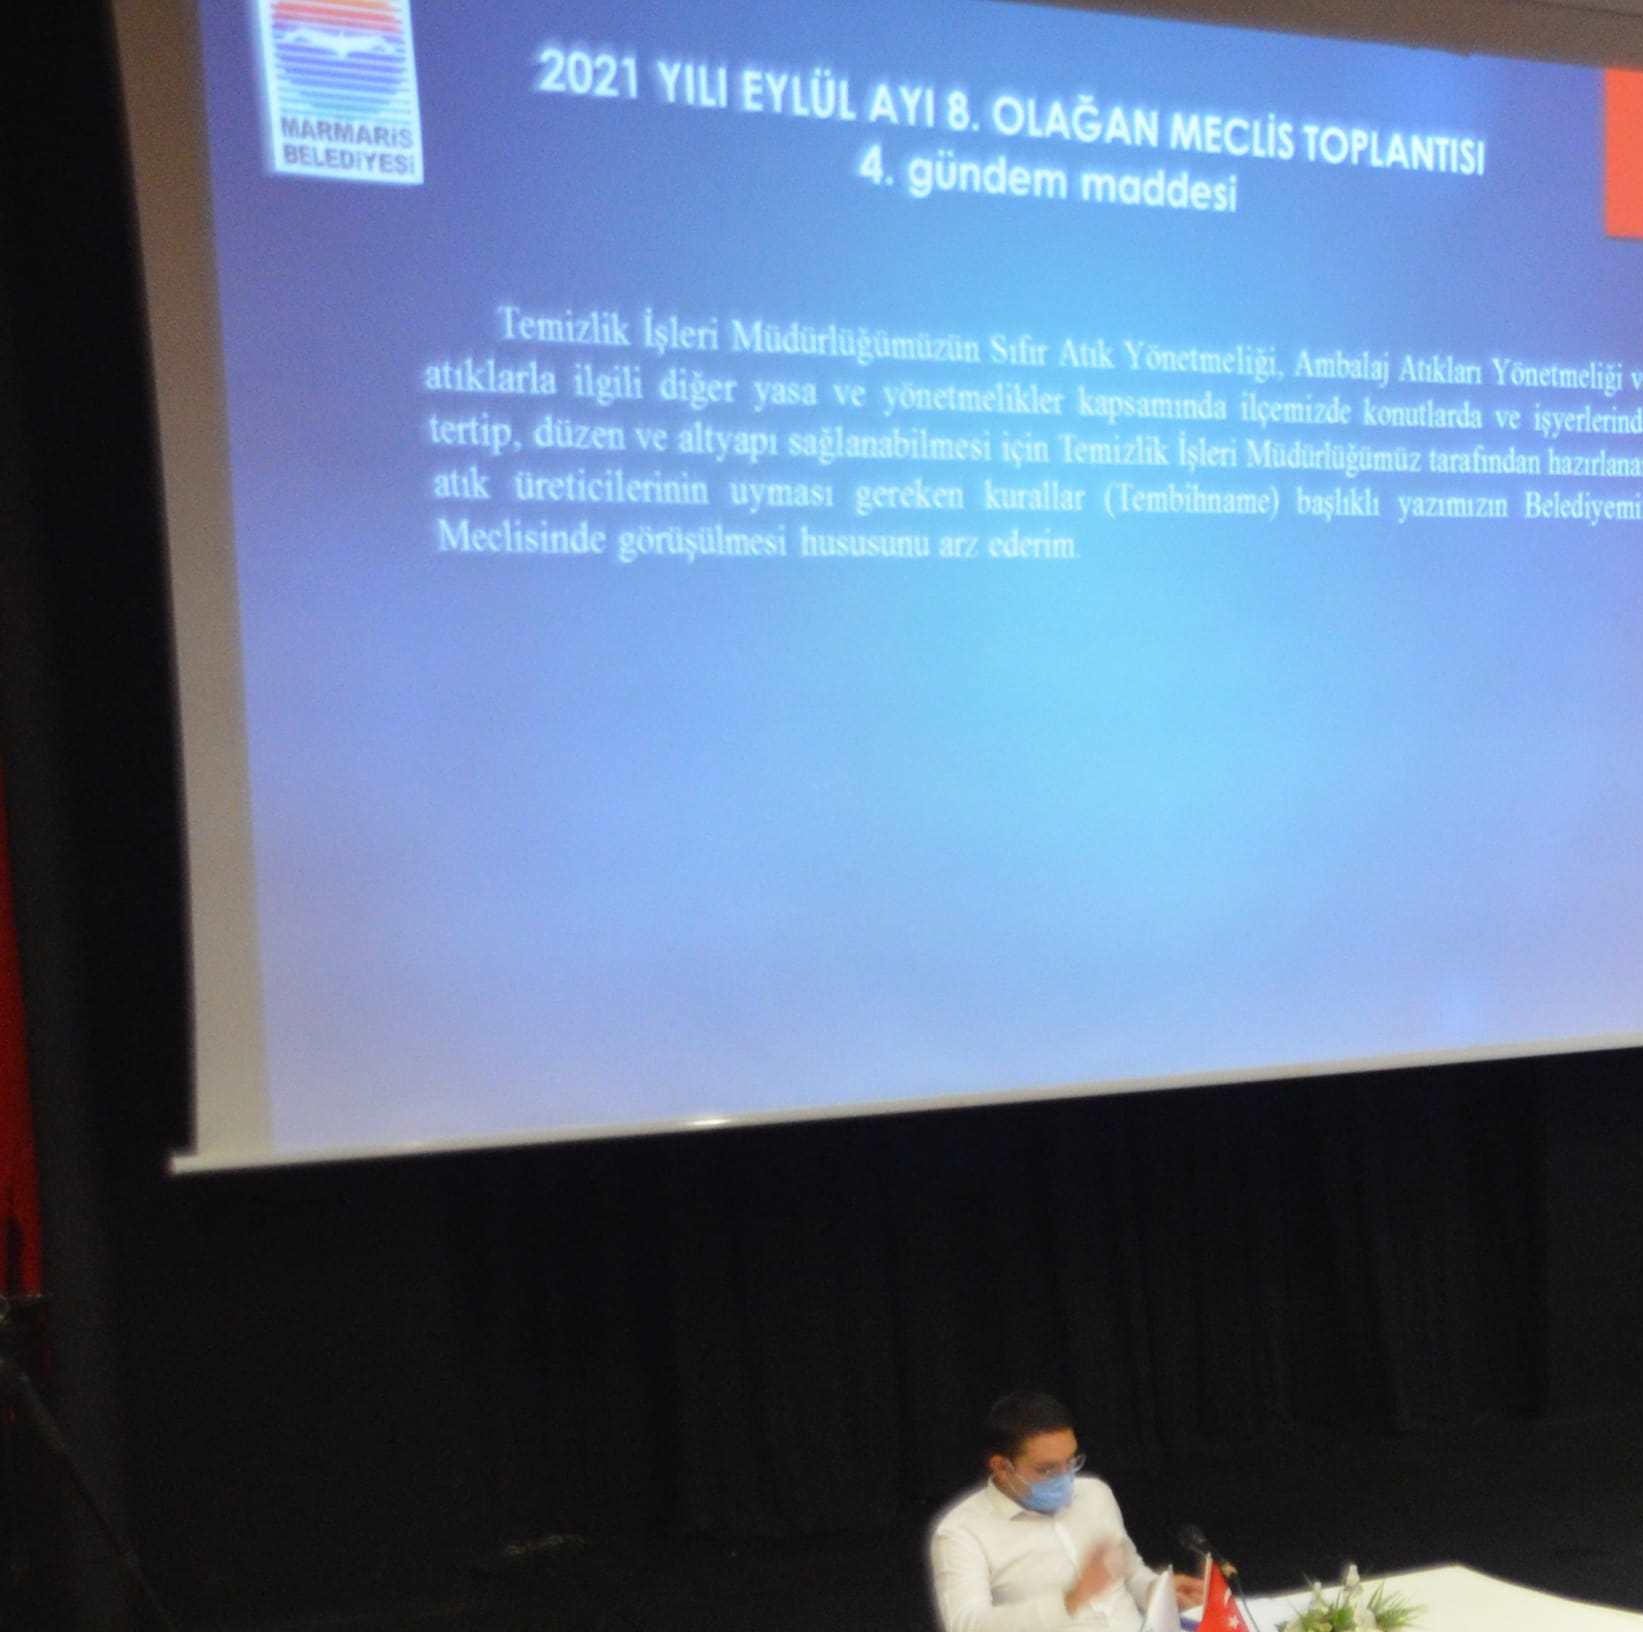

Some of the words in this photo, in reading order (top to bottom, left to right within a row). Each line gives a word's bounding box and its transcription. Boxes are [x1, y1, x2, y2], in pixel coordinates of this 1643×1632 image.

[537, 47, 638, 99] 2021
[657, 60, 727, 107] YILI
[742, 67, 856, 121] EYLÜL
[869, 83, 935, 127] AYI
[946, 91, 979, 132] 8.
[993, 94, 1158, 148] OLAĞAN
[1303, 125, 1486, 177] TOPLANTISI
[858, 144, 894, 186] 4.
[908, 149, 1067, 199] gündem
[1081, 169, 1237, 213] maddesi
[500, 306, 630, 346] Temizlik
[731, 318, 981, 366] Müdürlüğümüzün
[1060, 337, 1114, 369] Atık
[1295, 348, 1390, 388] Ambalaj
[1492, 357, 1625, 396] Yönetmeliği
[424, 356, 557, 396] atıklarla
[575, 363, 643, 406] ilgili
[659, 368, 737, 410] diğer
[752, 380, 817, 413] yasa
[833, 382, 865, 407] ve
[882, 382, 1064, 416] yönetmelikler
[1078, 385, 1227, 424] kapsamında
[1241, 390, 1352, 428] ilçemizde
[1363, 398, 1483, 430] konutlarda
[1496, 407, 1521, 430] ve
[429, 412, 522, 457] tertip,
[533, 414, 626, 451] düzen
[636, 426, 667, 451] ve
[678, 421, 778, 463] altyapı
[788, 426, 992, 465] sağlanabilmesi
[1002, 430, 1049, 468] için
[1058, 433, 1169, 466] Temizlik
[1246, 437, 1422, 478] Müdürlüğümüz
[1429, 445, 1541, 476] tarafından
[434, 465, 490, 500] atık
[515, 467, 709, 506] üreticilerinin
[730, 482, 833, 515] uyması
[855, 478, 965, 516] gereken
[984, 479, 1085, 513] kurallar
[1104, 481, 1280, 522] (Tembihname)
[1397, 495, 1509, 524] yazımızın
[436, 517, 607, 556] Meclisinde
[618, 523, 788, 564] görüşülmesi
[801, 526, 930, 559] hususunu
[938, 533, 978, 559] arz
[988, 528, 1081, 560] ederim.
